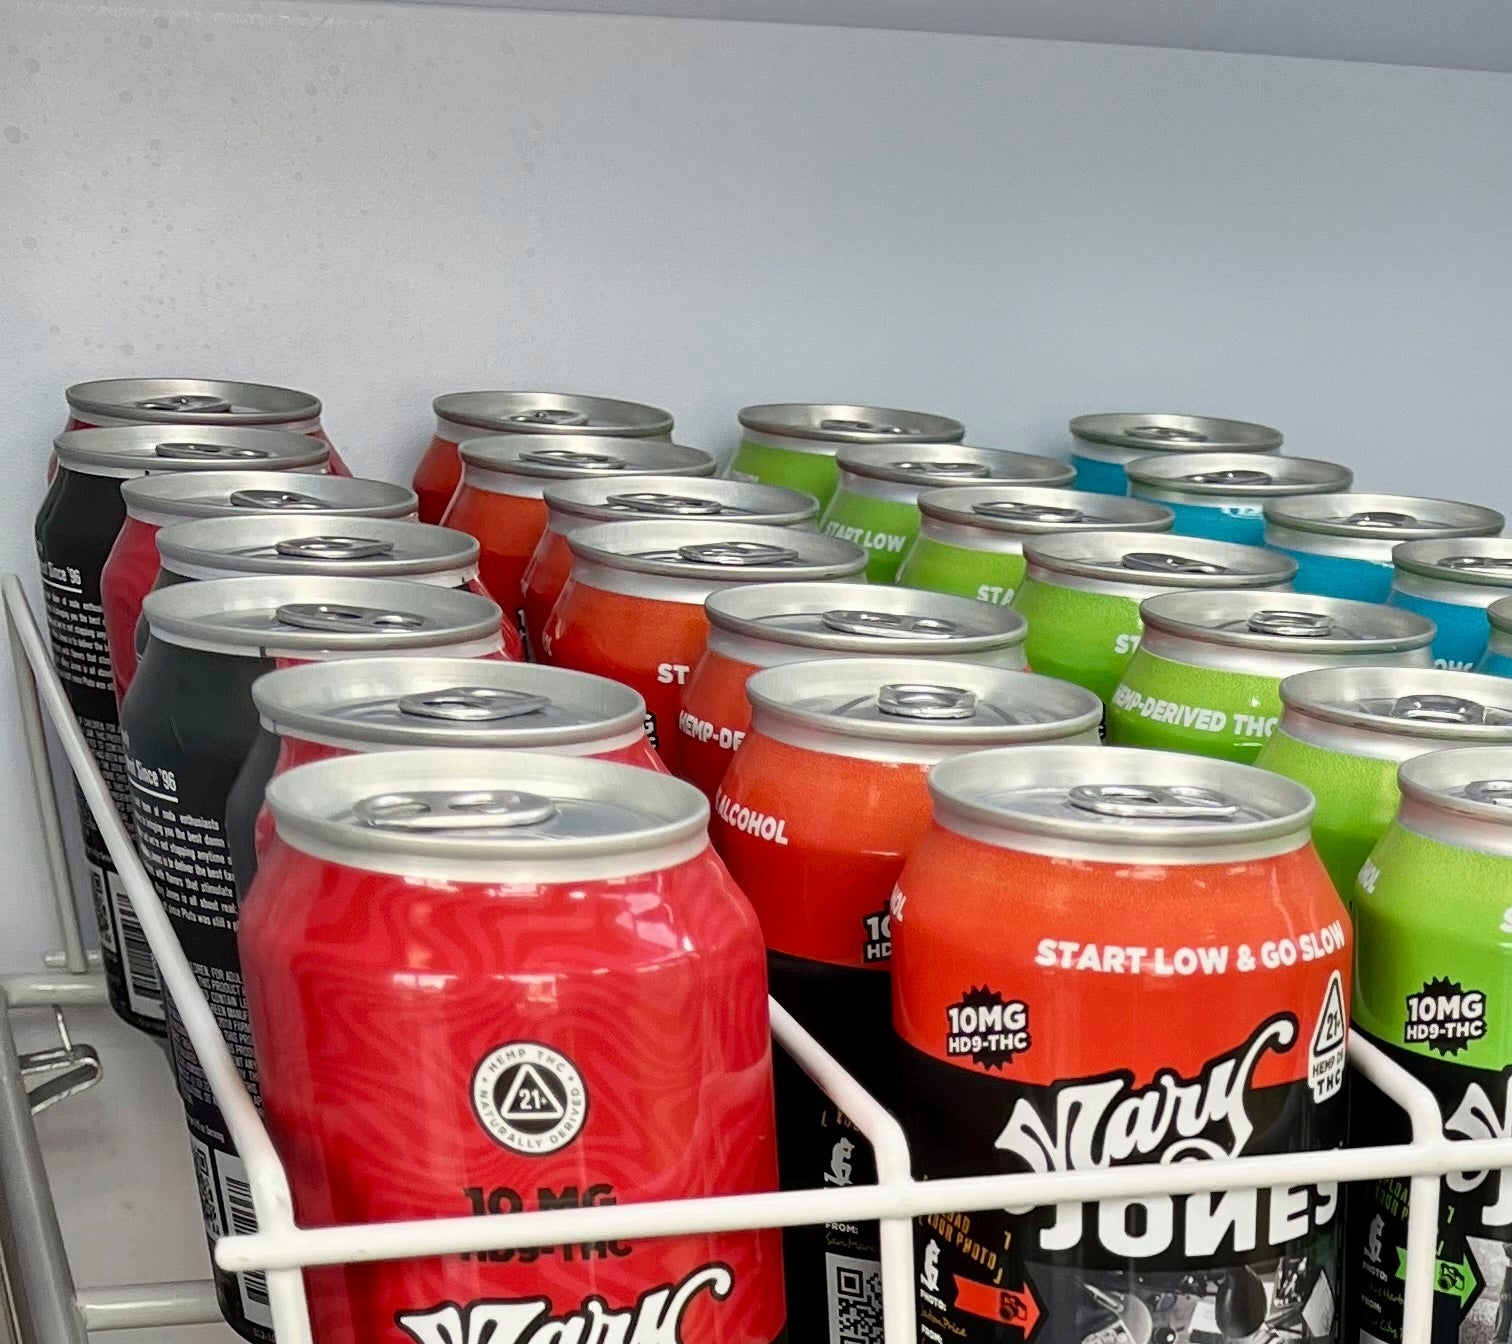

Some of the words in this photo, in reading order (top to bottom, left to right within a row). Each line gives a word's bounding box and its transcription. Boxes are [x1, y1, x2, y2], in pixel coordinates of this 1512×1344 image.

[1035, 939, 1153, 974] START
[1155, 945, 1230, 976] LOW
[1236, 944, 1256, 971] &
[1260, 939, 1298, 968] GO
[1300, 920, 1347, 962] SLOW
[948, 1001, 1027, 1033] 10MG
[1408, 991, 1483, 1022] 10MG
[948, 1032, 1028, 1054] HD9-THC
[1406, 1021, 1484, 1040] HD9-THC
[995, 1018, 1294, 1215] Mary
[1039, 1179, 1339, 1258] JONES
